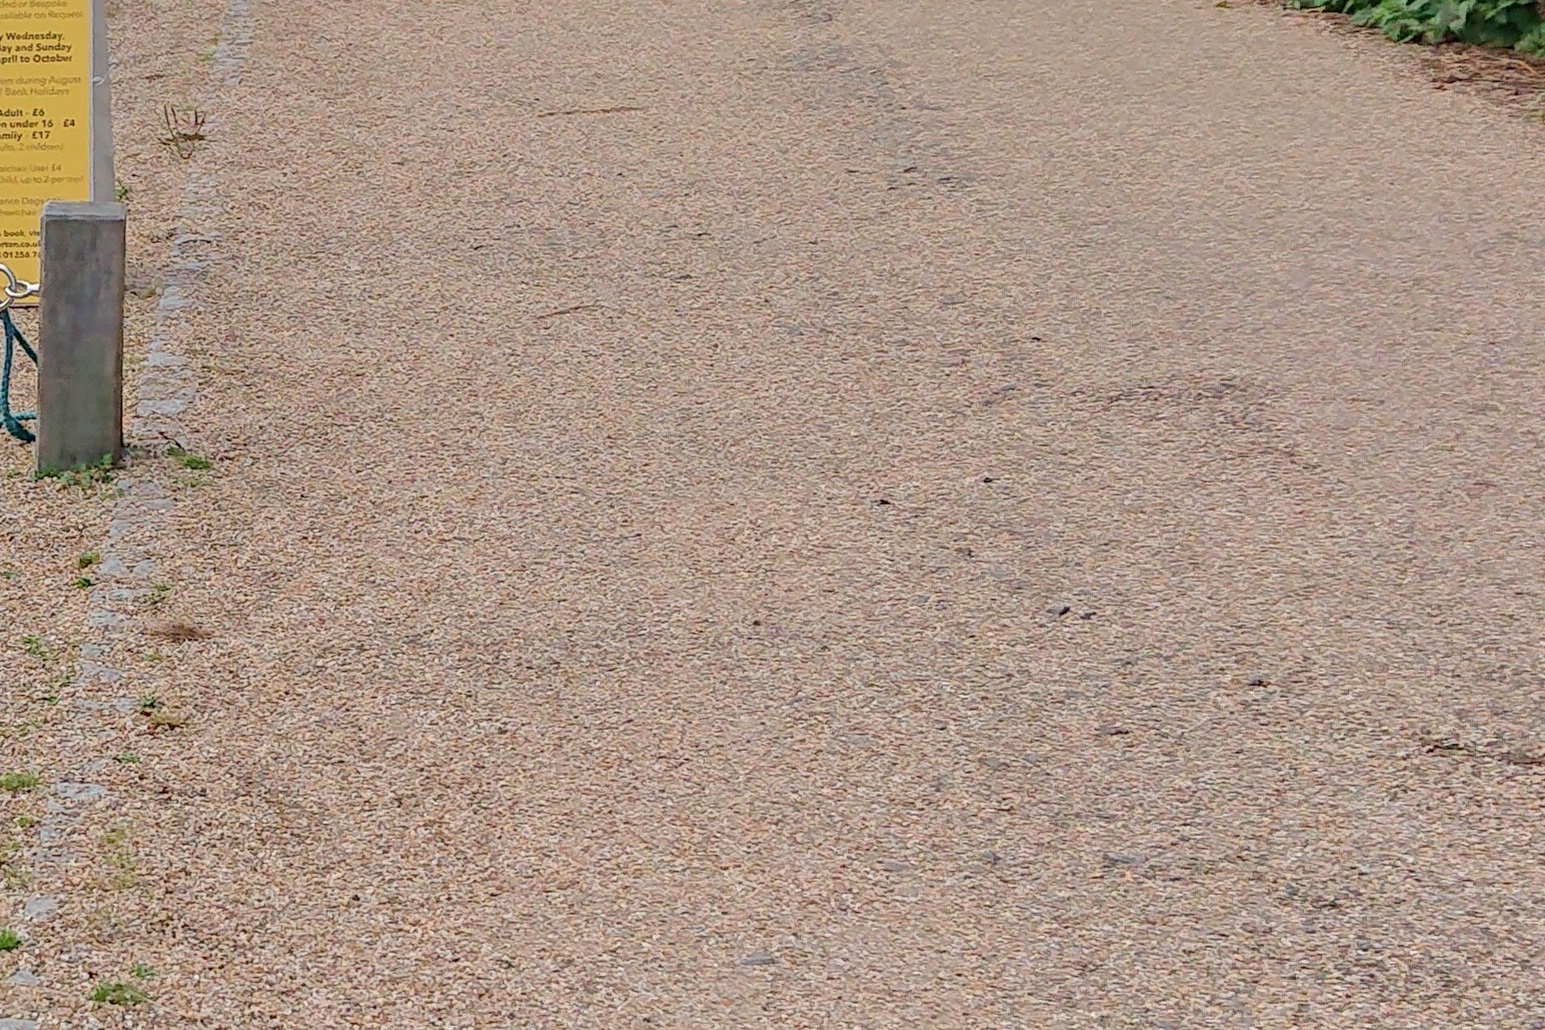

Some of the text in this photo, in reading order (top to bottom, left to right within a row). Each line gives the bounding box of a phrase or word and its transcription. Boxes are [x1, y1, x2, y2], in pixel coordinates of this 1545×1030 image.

[15, 43, 33, 52] and
[36, 43, 72, 53] Sunday
[20, 55, 30, 63] to
[33, 54, 73, 63] October
[32, 108, 45, 117] £6
[9, 120, 39, 128] under
[41, 119, 54, 128] 16
[63, 119, 76, 128] £4
[32, 131, 51, 140] £17
[2, 251, 30, 259] 01256
